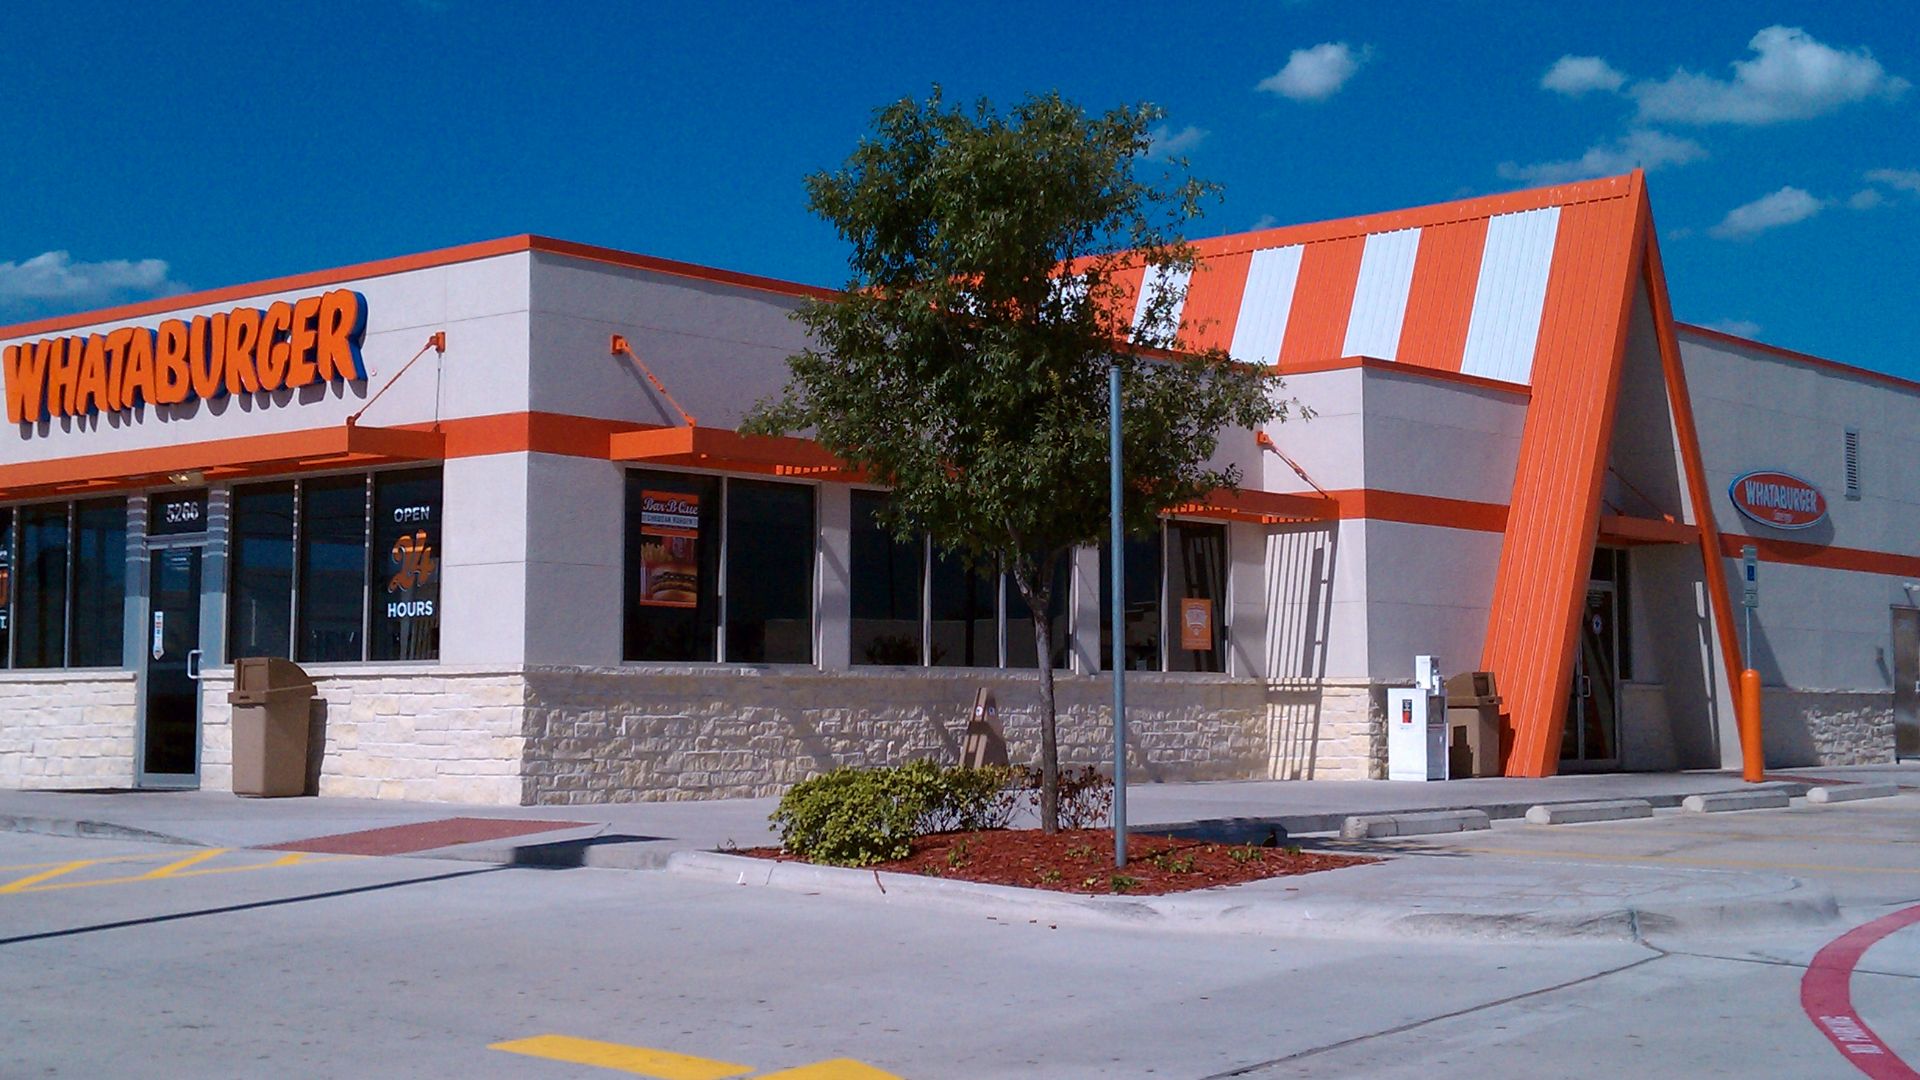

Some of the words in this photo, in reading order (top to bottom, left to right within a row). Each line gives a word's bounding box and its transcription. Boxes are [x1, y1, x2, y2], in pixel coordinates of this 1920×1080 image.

[3, 289, 368, 424] WHATABURGER
[1744, 480, 1817, 512] WHATABURGER
[167, 502, 199, 522] 5266
[393, 506, 430, 522] OPEN
[388, 528, 435, 593] 24
[387, 601, 433, 618] HOURS
